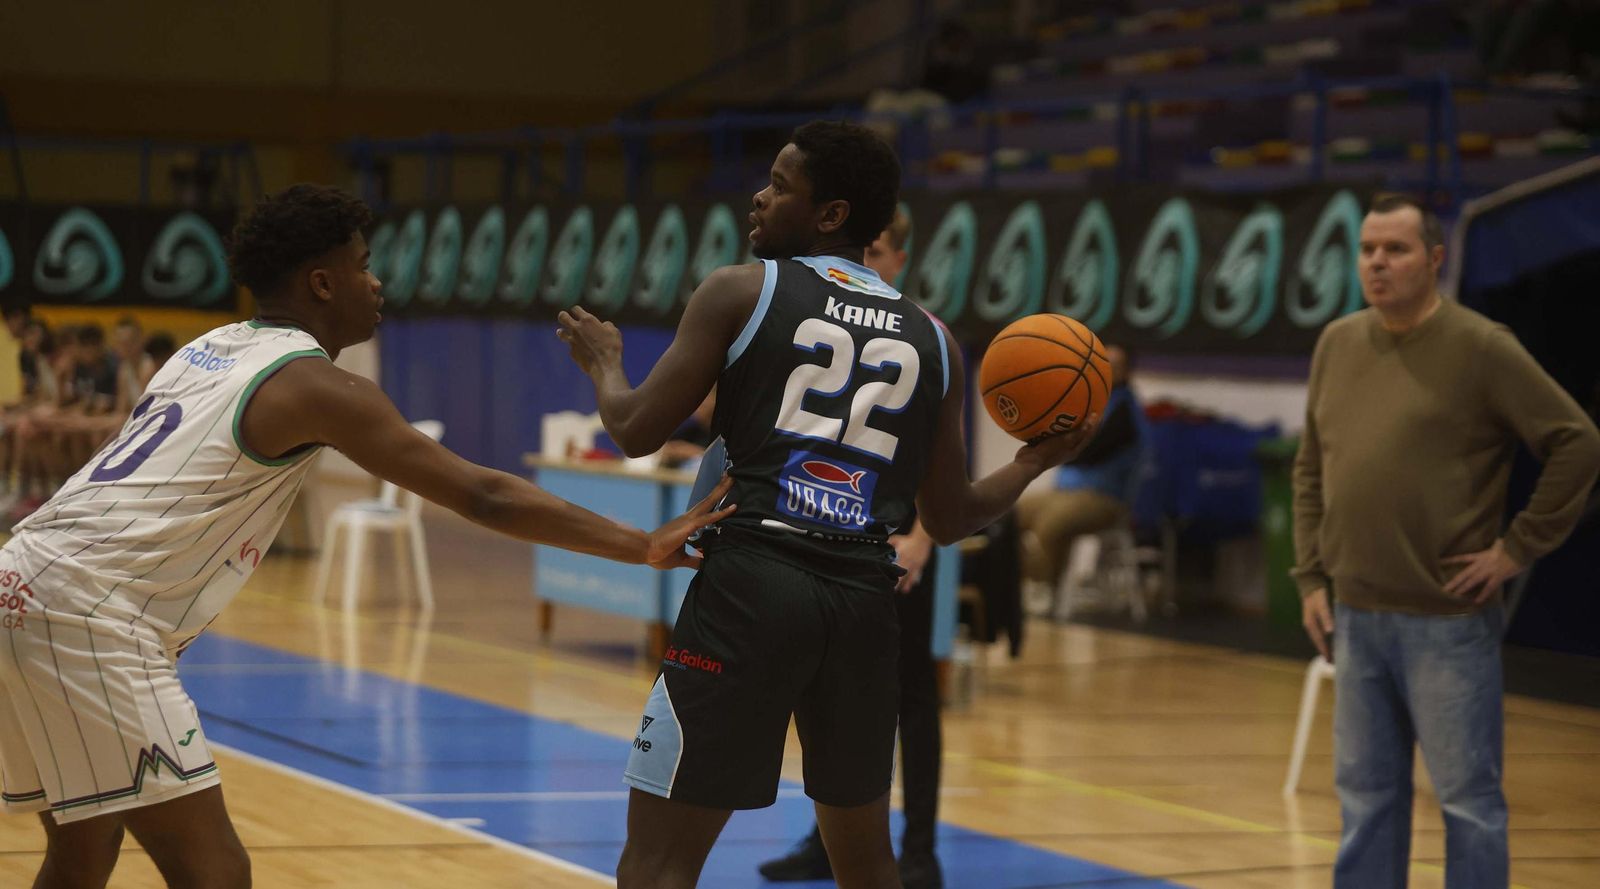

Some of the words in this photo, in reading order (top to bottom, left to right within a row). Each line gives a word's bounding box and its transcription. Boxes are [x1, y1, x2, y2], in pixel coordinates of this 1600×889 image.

[824, 296, 902, 333] KANE
[775, 317, 920, 464] 22
[0, 592, 28, 614] SOL
